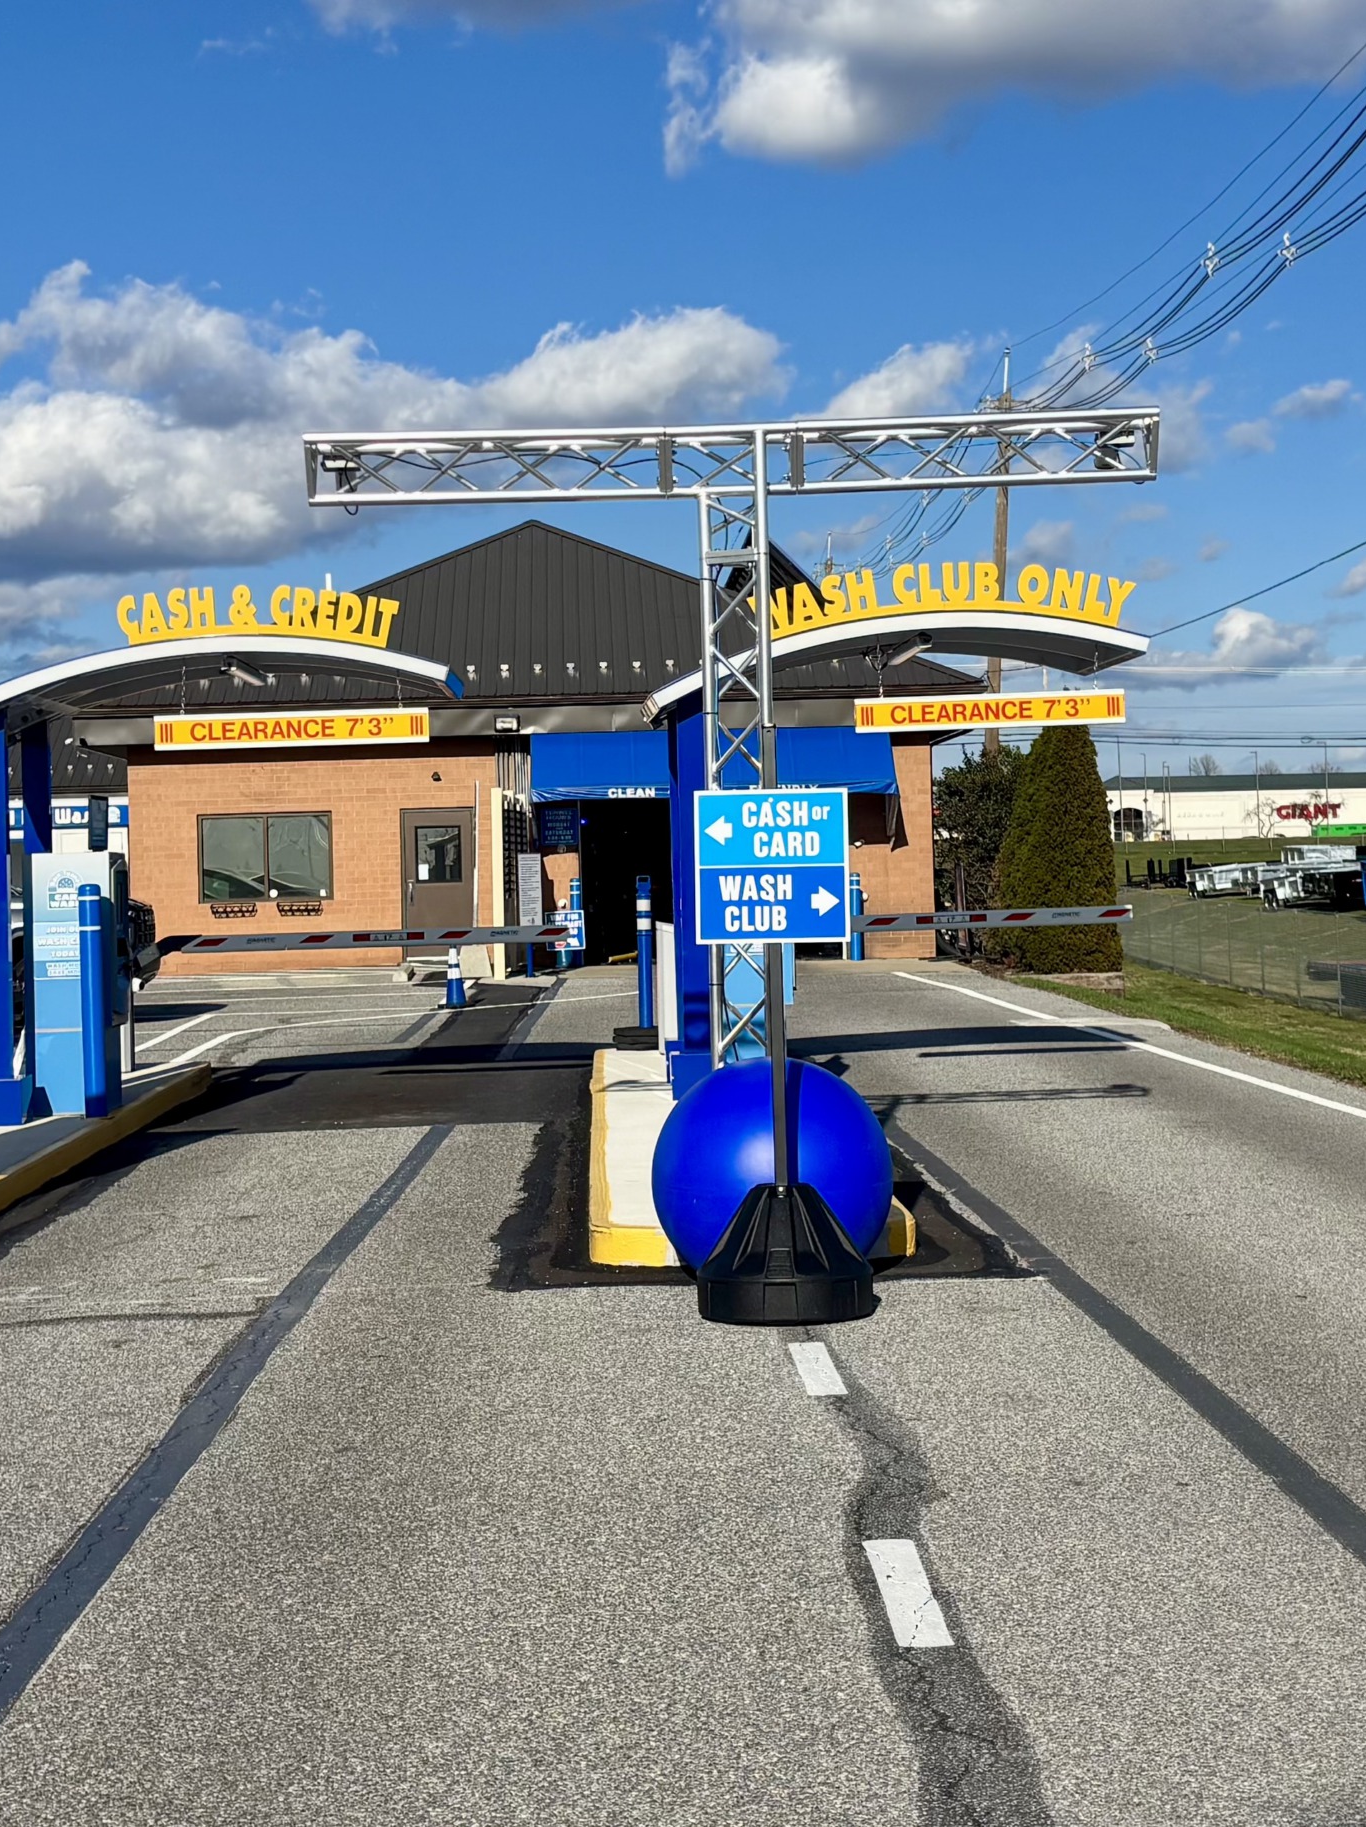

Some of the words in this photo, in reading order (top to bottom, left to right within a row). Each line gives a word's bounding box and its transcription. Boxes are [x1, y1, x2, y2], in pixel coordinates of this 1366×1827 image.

[747, 569, 880, 638] WASH
[892, 562, 999, 606] CLUB
[1017, 564, 1136, 625] ONLY
[117, 587, 216, 637] CASH
[229, 585, 257, 627] &
[270, 585, 400, 642] CREDIT
[890, 702, 1033, 725] CLEARANCE
[190, 718, 335, 742] CLEARANCE
[608, 788, 655, 798] CLEAN
[54, 808, 90, 824] Was
[742, 800, 809, 828] CASH
[811, 806, 830, 820] or
[1276, 803, 1341, 820] GIANT
[753, 831, 820, 858] CARD
[719, 874, 793, 902] WASH
[46, 926, 67, 934] JOIN
[724, 905, 787, 932] CLUB
[38, 937, 67, 947] WASH
